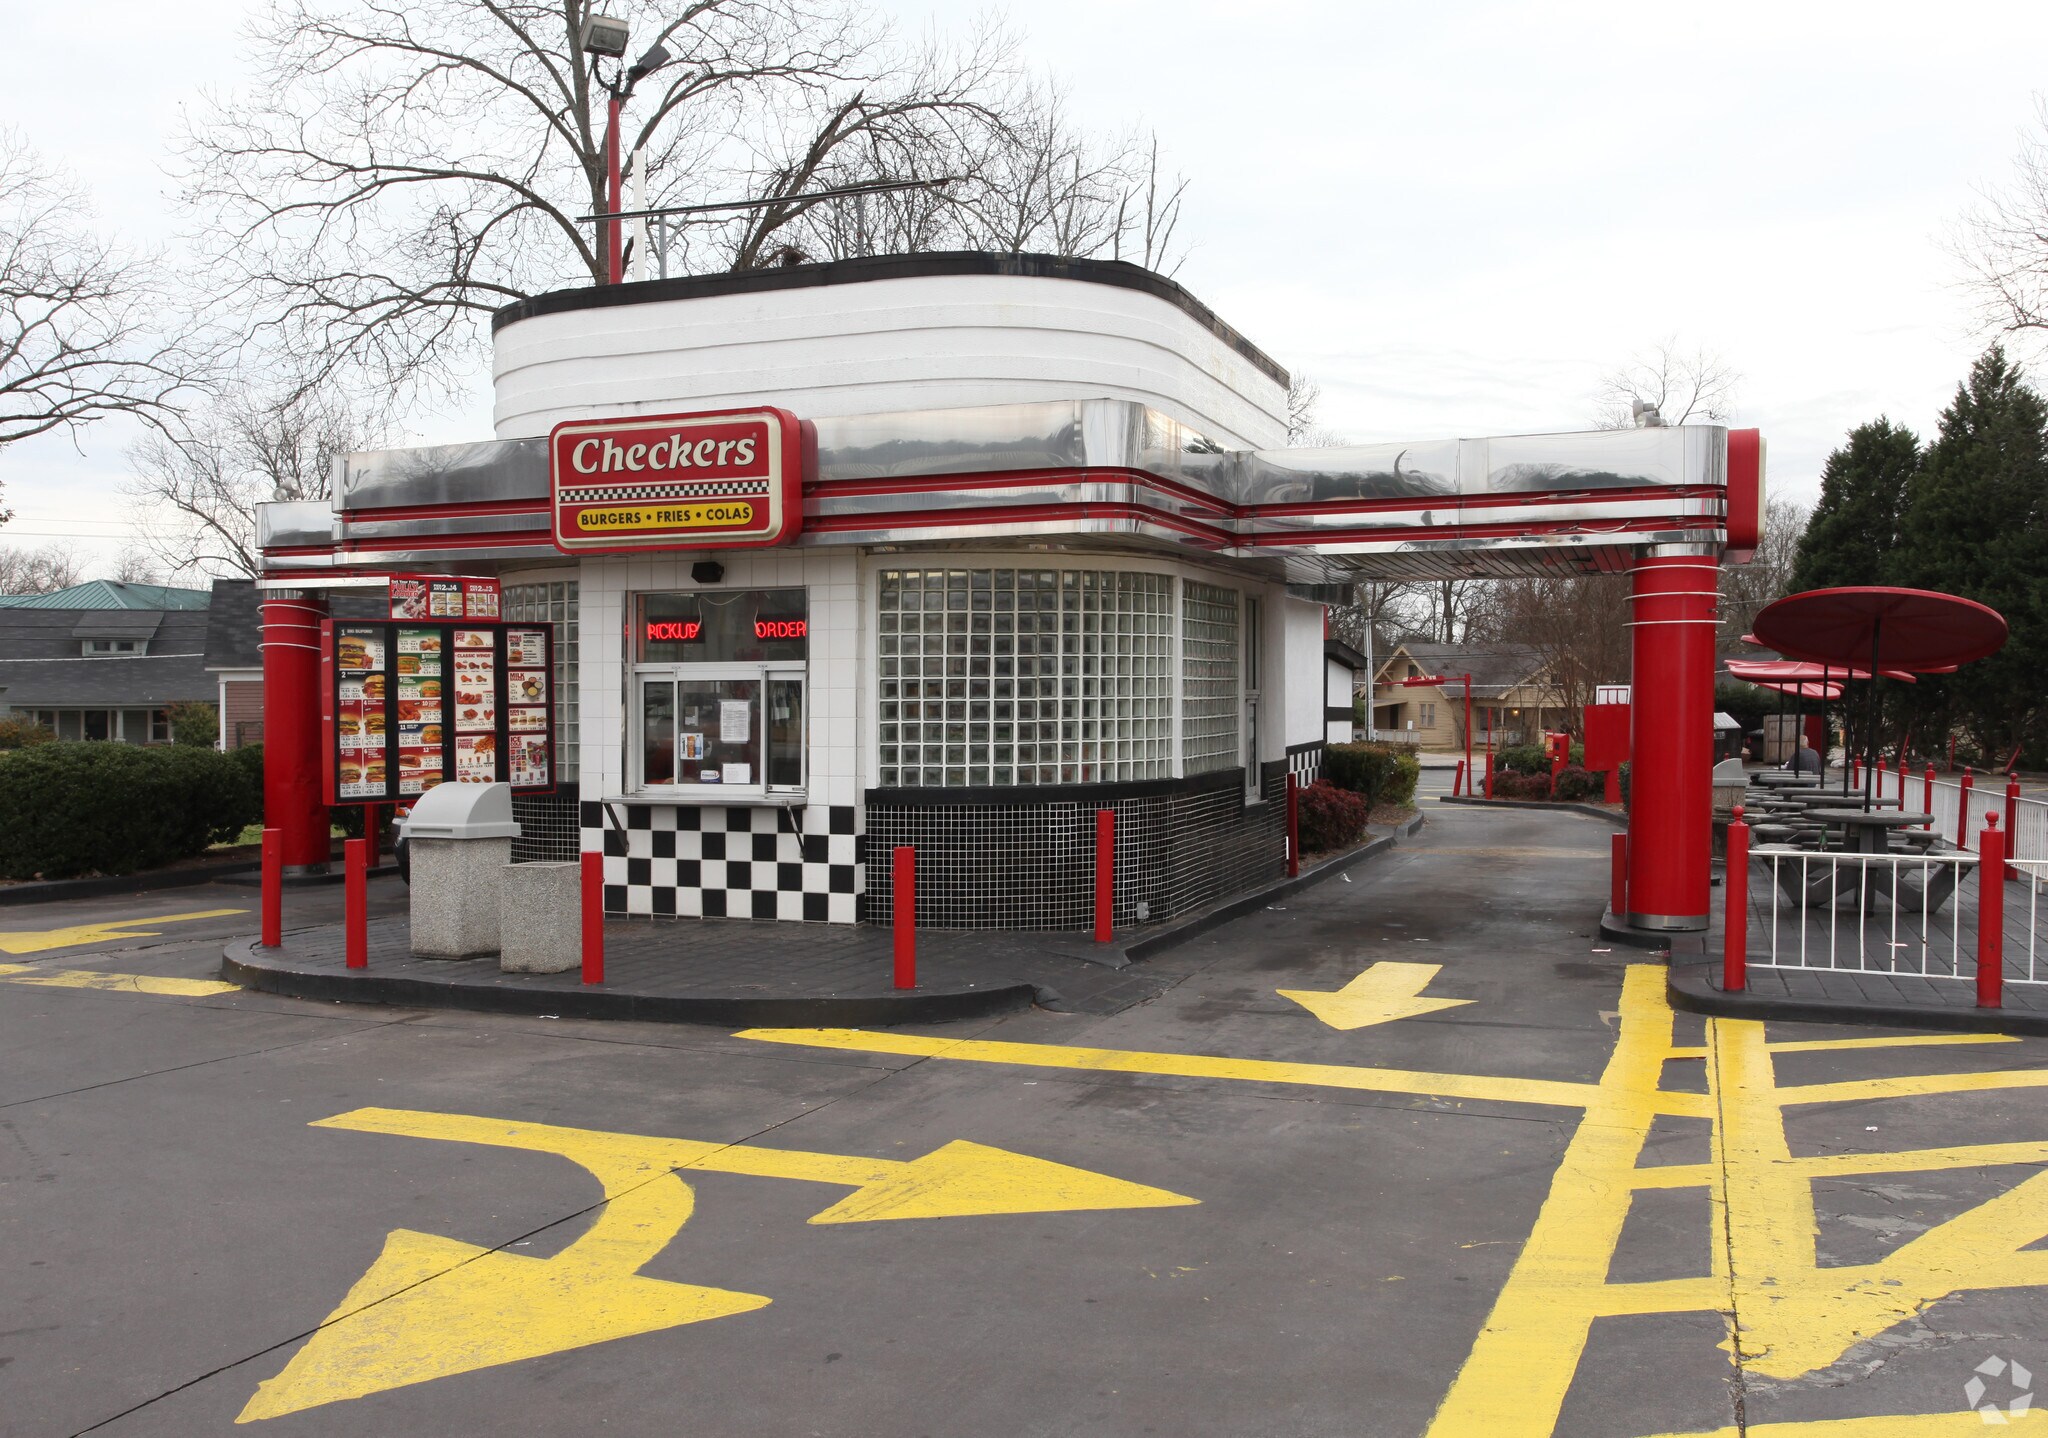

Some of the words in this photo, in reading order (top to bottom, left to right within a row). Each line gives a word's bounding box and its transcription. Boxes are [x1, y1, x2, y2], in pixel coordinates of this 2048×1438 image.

[572, 433, 755, 474] Checkers
[581, 512, 641, 526] BURGERS
[656, 510, 691, 523] FRIES
[706, 507, 750, 521] COLAS
[391, 583, 419, 591] FULLY
[647, 622, 698, 640] PICKUP
[755, 621, 807, 639] ORDER
